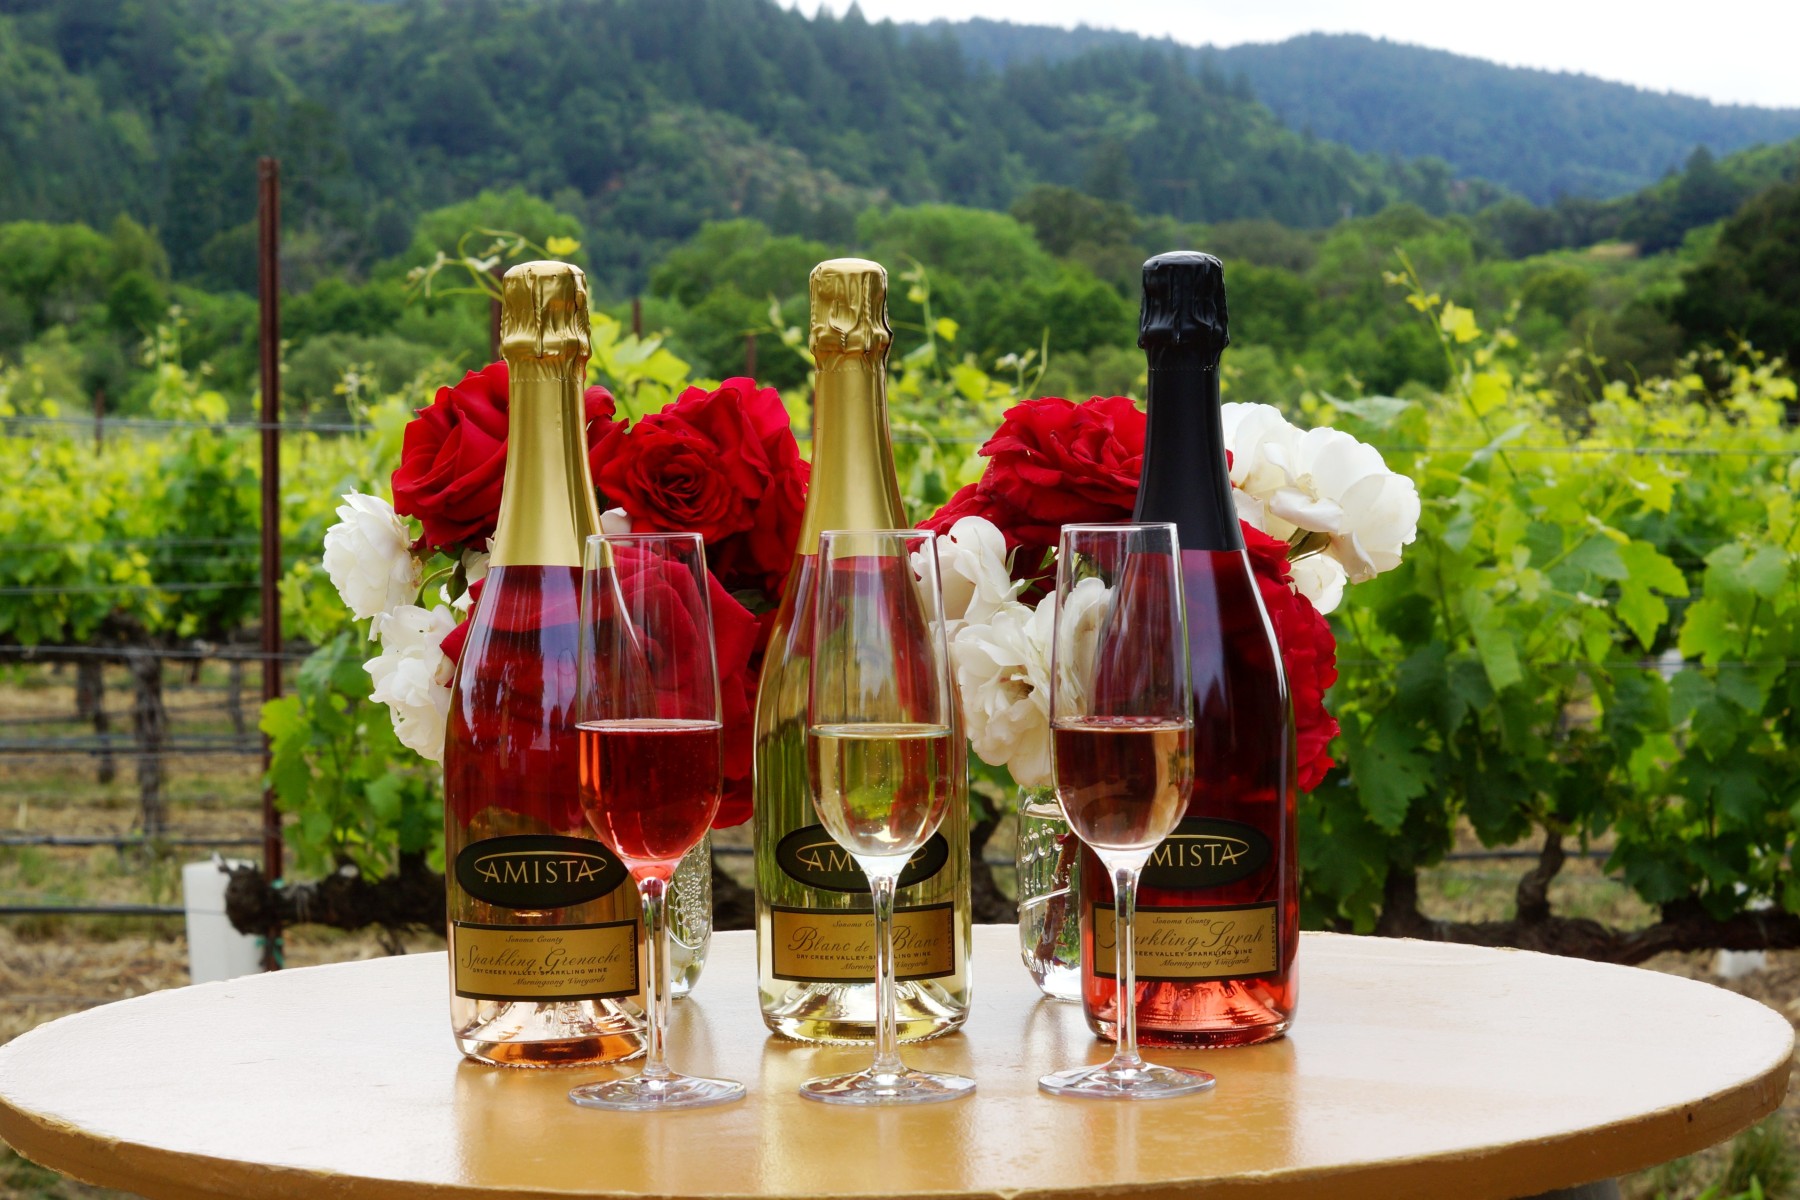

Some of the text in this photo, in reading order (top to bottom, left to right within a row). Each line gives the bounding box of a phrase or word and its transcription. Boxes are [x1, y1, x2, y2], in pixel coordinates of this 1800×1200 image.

[1146, 843, 1238, 867] MISTA
[484, 859, 595, 884] AMISTA
[1152, 916, 1212, 926] Sonoma County
[506, 934, 564, 945] Sonoma County
[787, 926, 851, 952] Blanc
[854, 940, 870, 952] de
[892, 925, 940, 951] Blanc
[1200, 920, 1265, 960] Syrah
[461, 943, 621, 973] Sparkling Grenache
[587, 966, 608, 974] WINE
